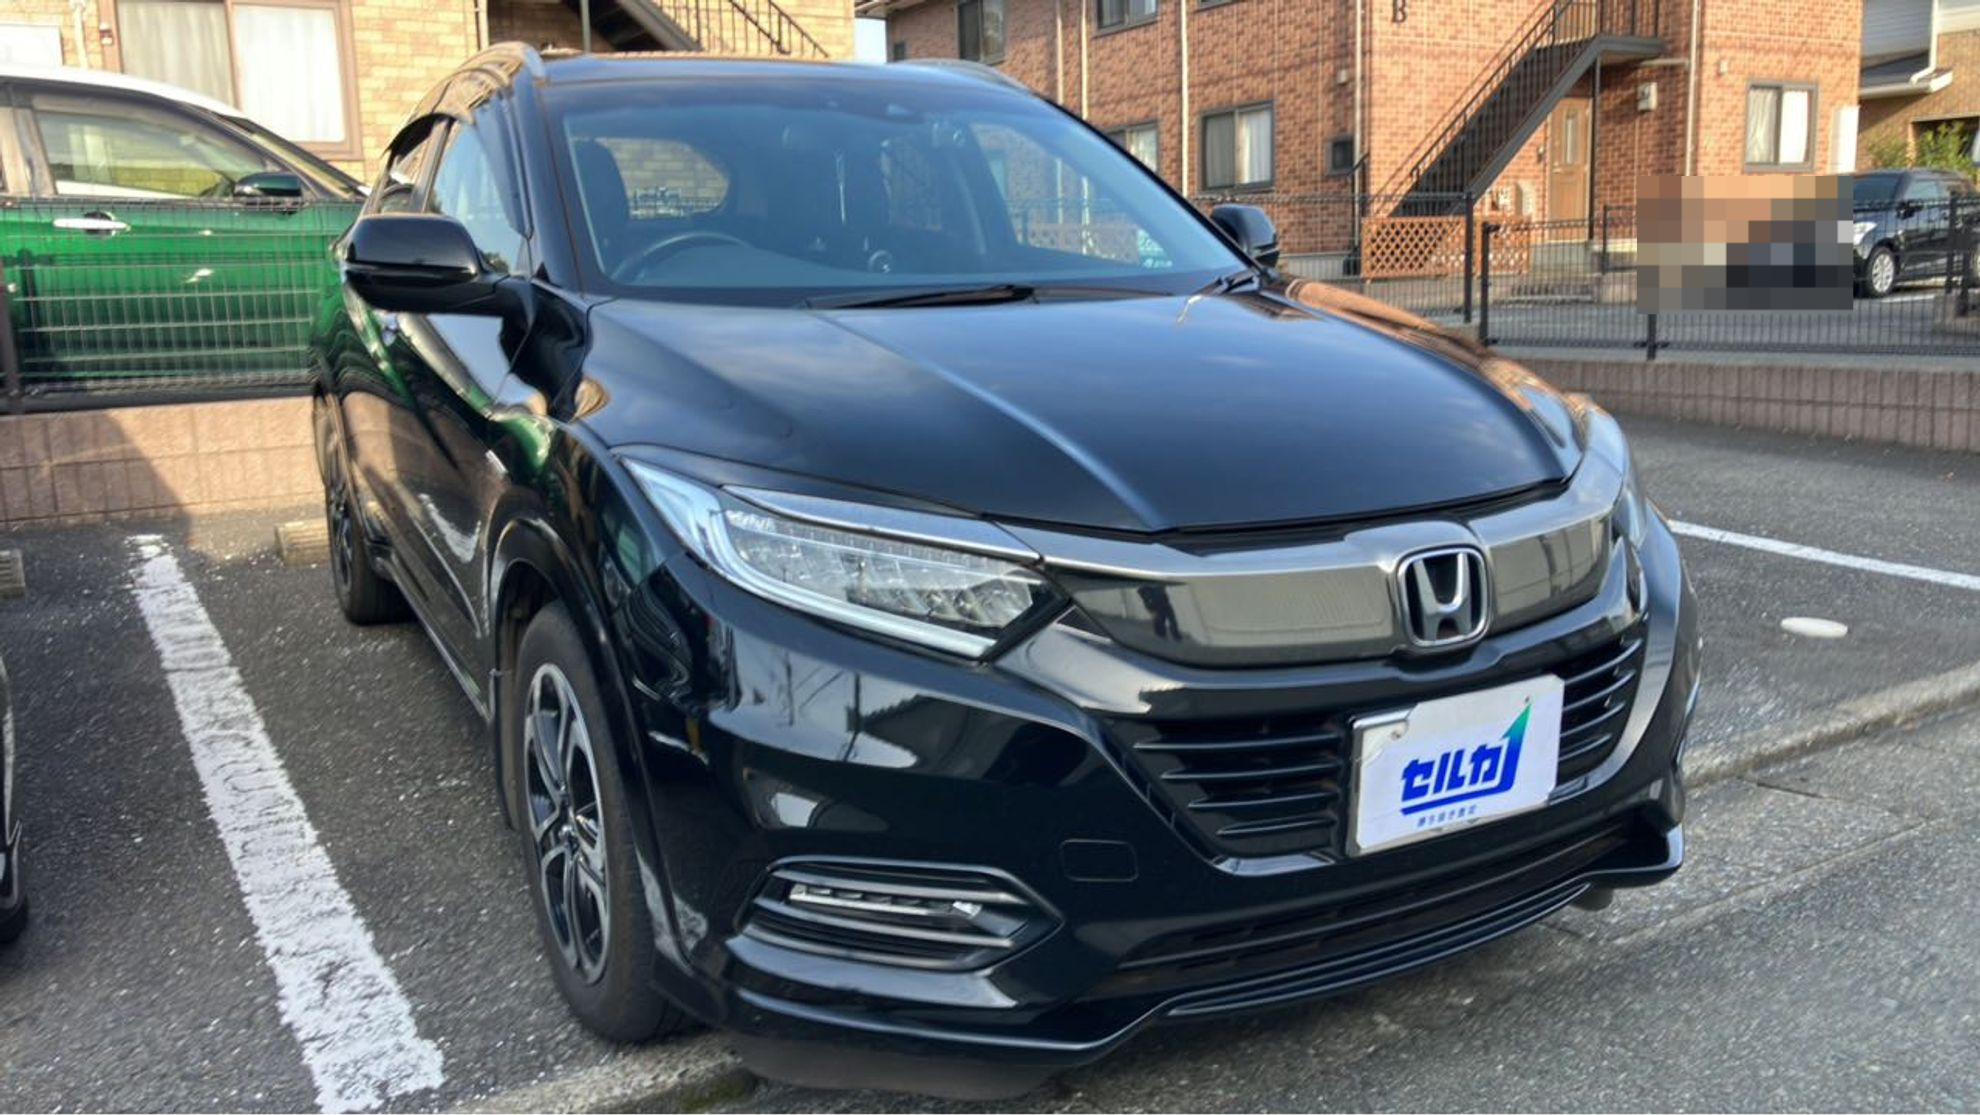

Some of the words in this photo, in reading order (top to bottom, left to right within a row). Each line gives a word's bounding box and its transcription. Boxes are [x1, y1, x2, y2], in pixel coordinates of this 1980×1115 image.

[1391, 0, 1407, 23] B
[1400, 744, 1503, 802] セルカ
